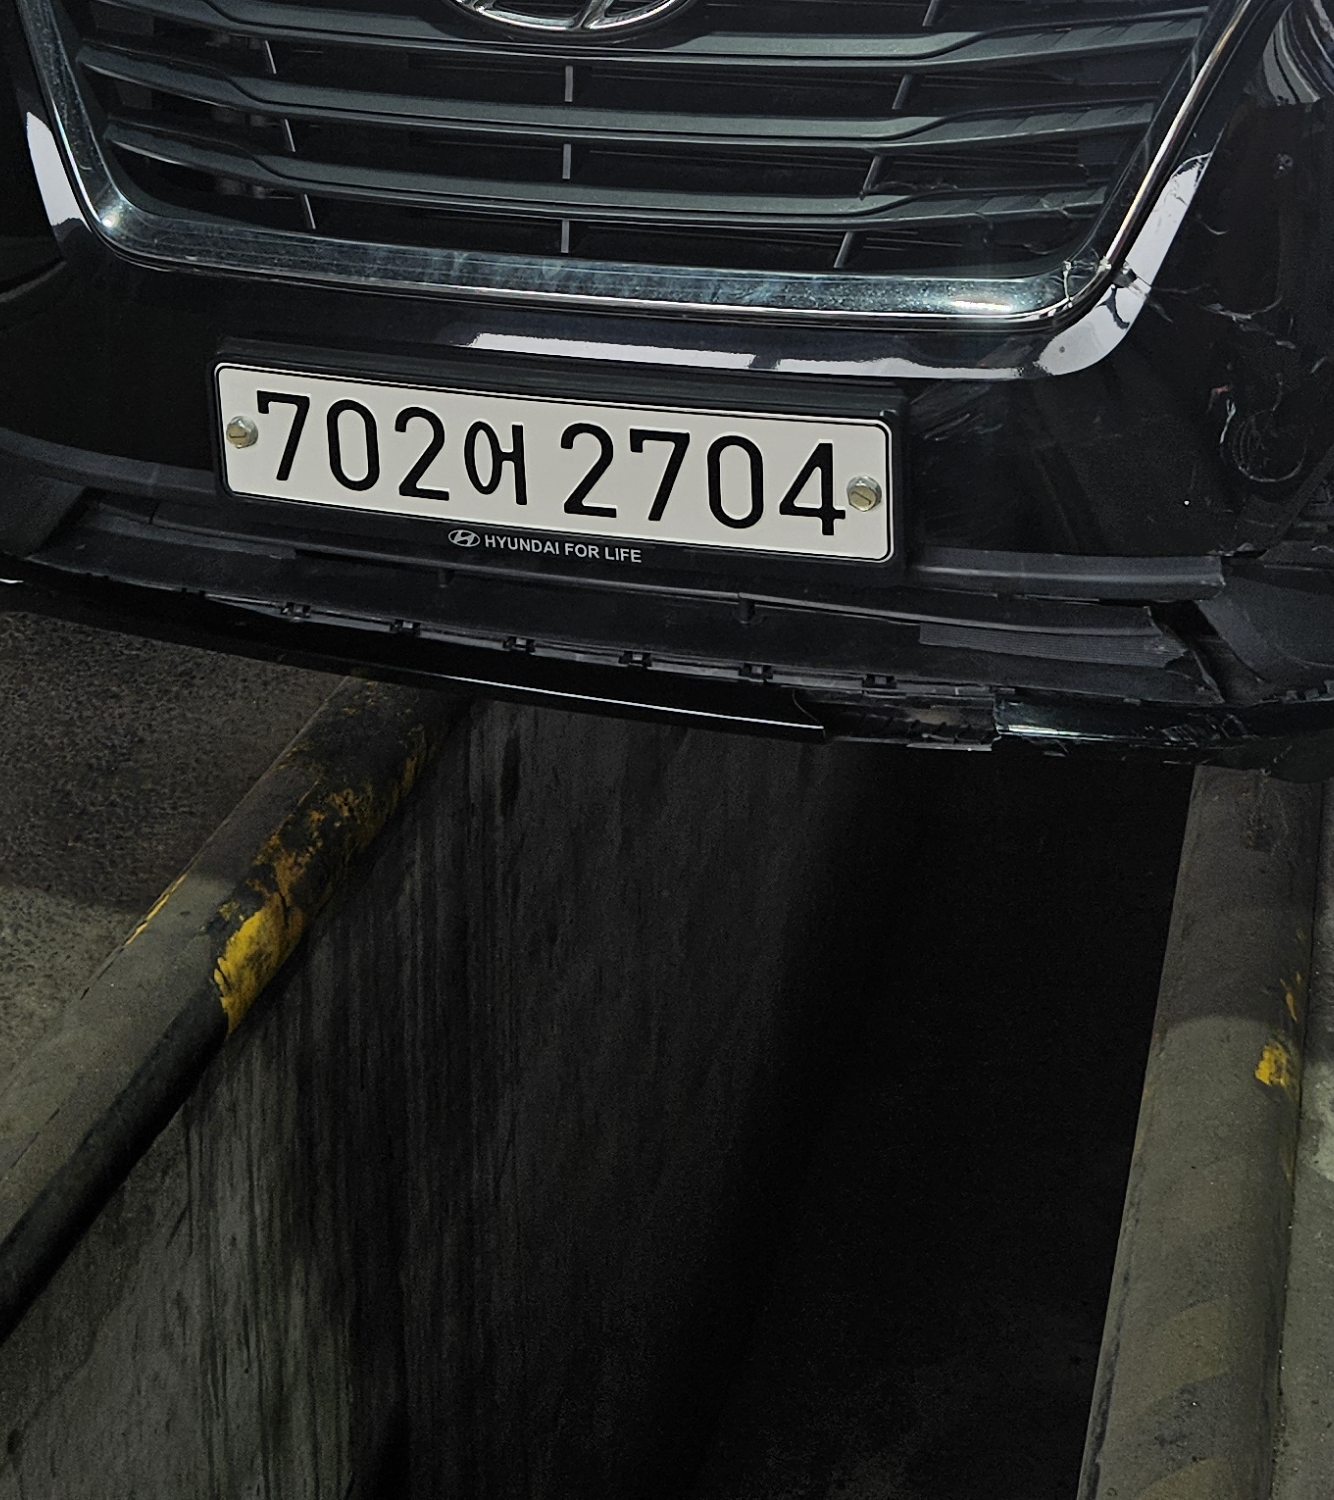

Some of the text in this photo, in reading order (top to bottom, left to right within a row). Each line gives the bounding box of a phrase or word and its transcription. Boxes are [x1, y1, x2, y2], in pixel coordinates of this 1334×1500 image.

[257, 390, 847, 536] 702어 2704
[484, 534, 643, 563] HYUNDAI FOR LIFE
